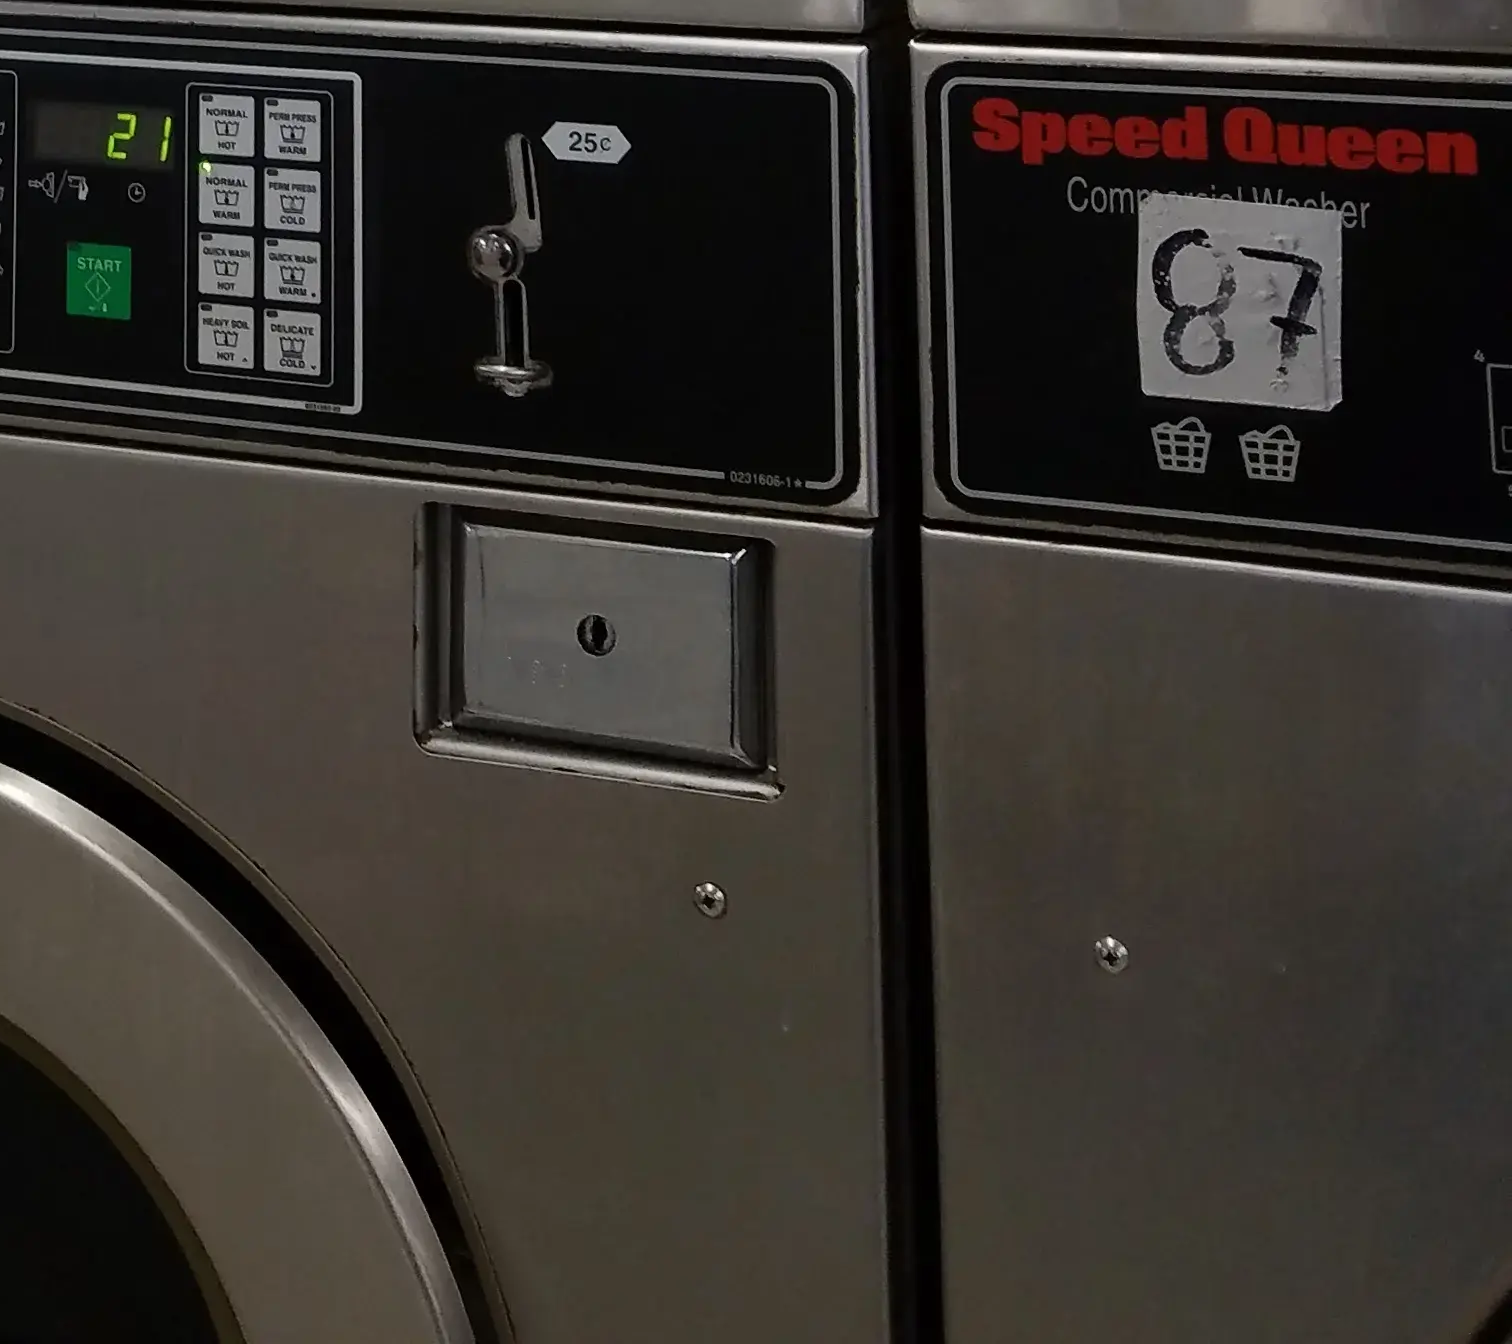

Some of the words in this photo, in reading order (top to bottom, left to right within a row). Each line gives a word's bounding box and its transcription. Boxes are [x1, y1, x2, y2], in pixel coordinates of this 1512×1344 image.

[206, 108, 248, 119] NORMAL
[107, 113, 172, 161] 21
[972, 97, 1208, 165] Speed
[1223, 107, 1478, 175] Queen
[218, 141, 236, 150] HOT
[279, 145, 307, 155] WARM
[205, 177, 248, 188] NORMAL
[213, 210, 241, 220] WARM
[280, 216, 306, 226] COLD
[77, 257, 122, 272] START
[217, 281, 236, 291] HOT
[279, 286, 307, 296] WARM
[1153, 228, 1323, 393] 87
[271, 323, 315, 335] DELICATE
[217, 351, 235, 361] HOT
[279, 358, 306, 369] COLD
